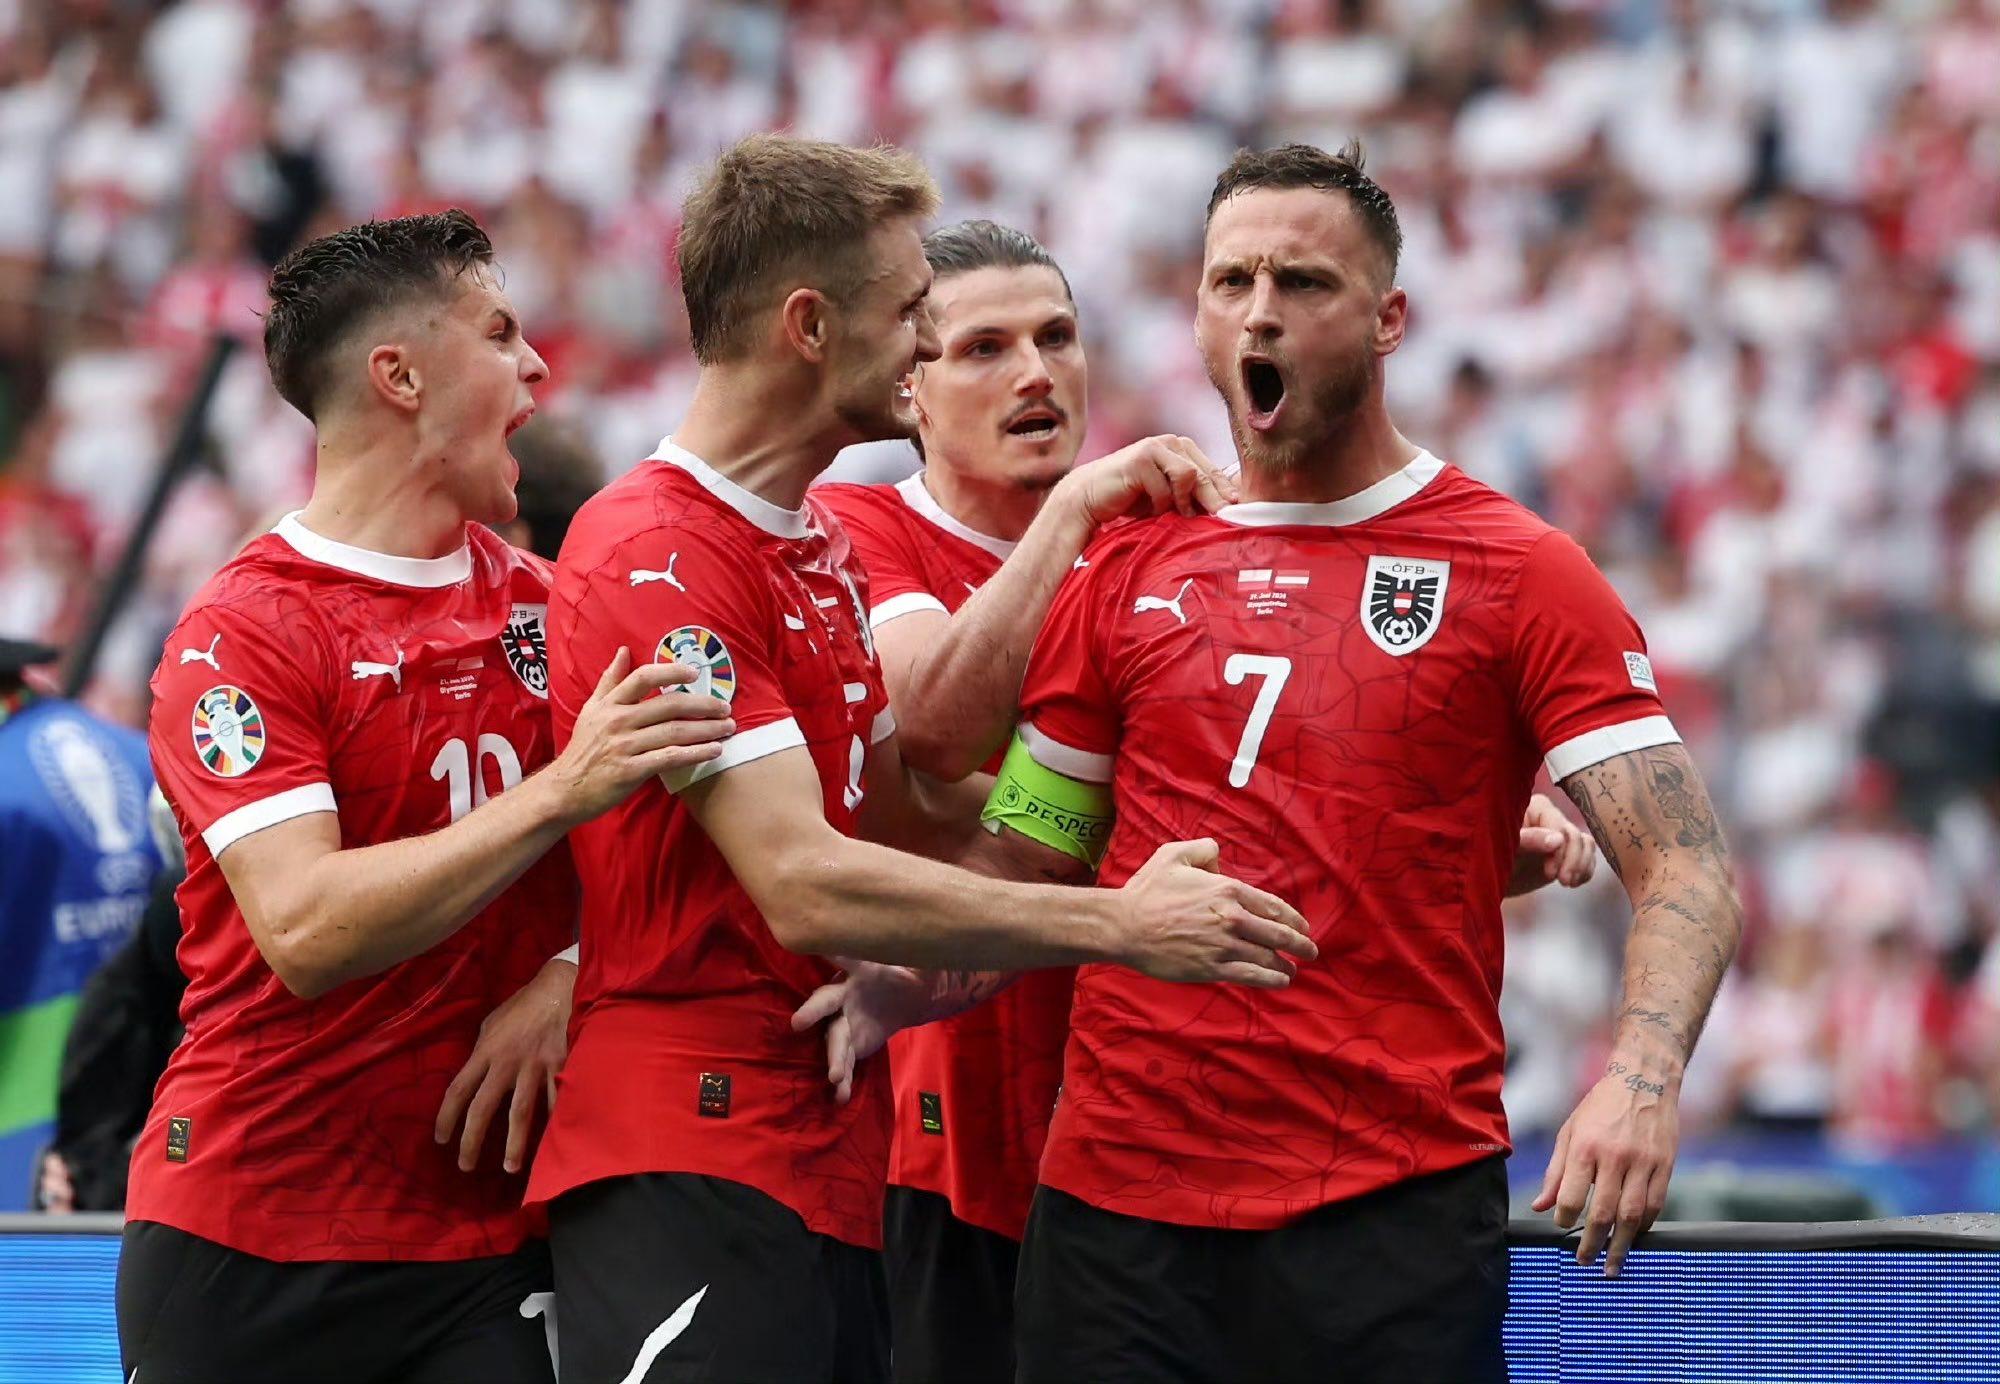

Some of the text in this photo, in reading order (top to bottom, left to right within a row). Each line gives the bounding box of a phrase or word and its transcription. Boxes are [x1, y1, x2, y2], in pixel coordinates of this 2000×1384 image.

[1392, 561, 1425, 575] ÖFB
[1223, 653, 1292, 788] 7
[430, 733, 523, 823] 10
